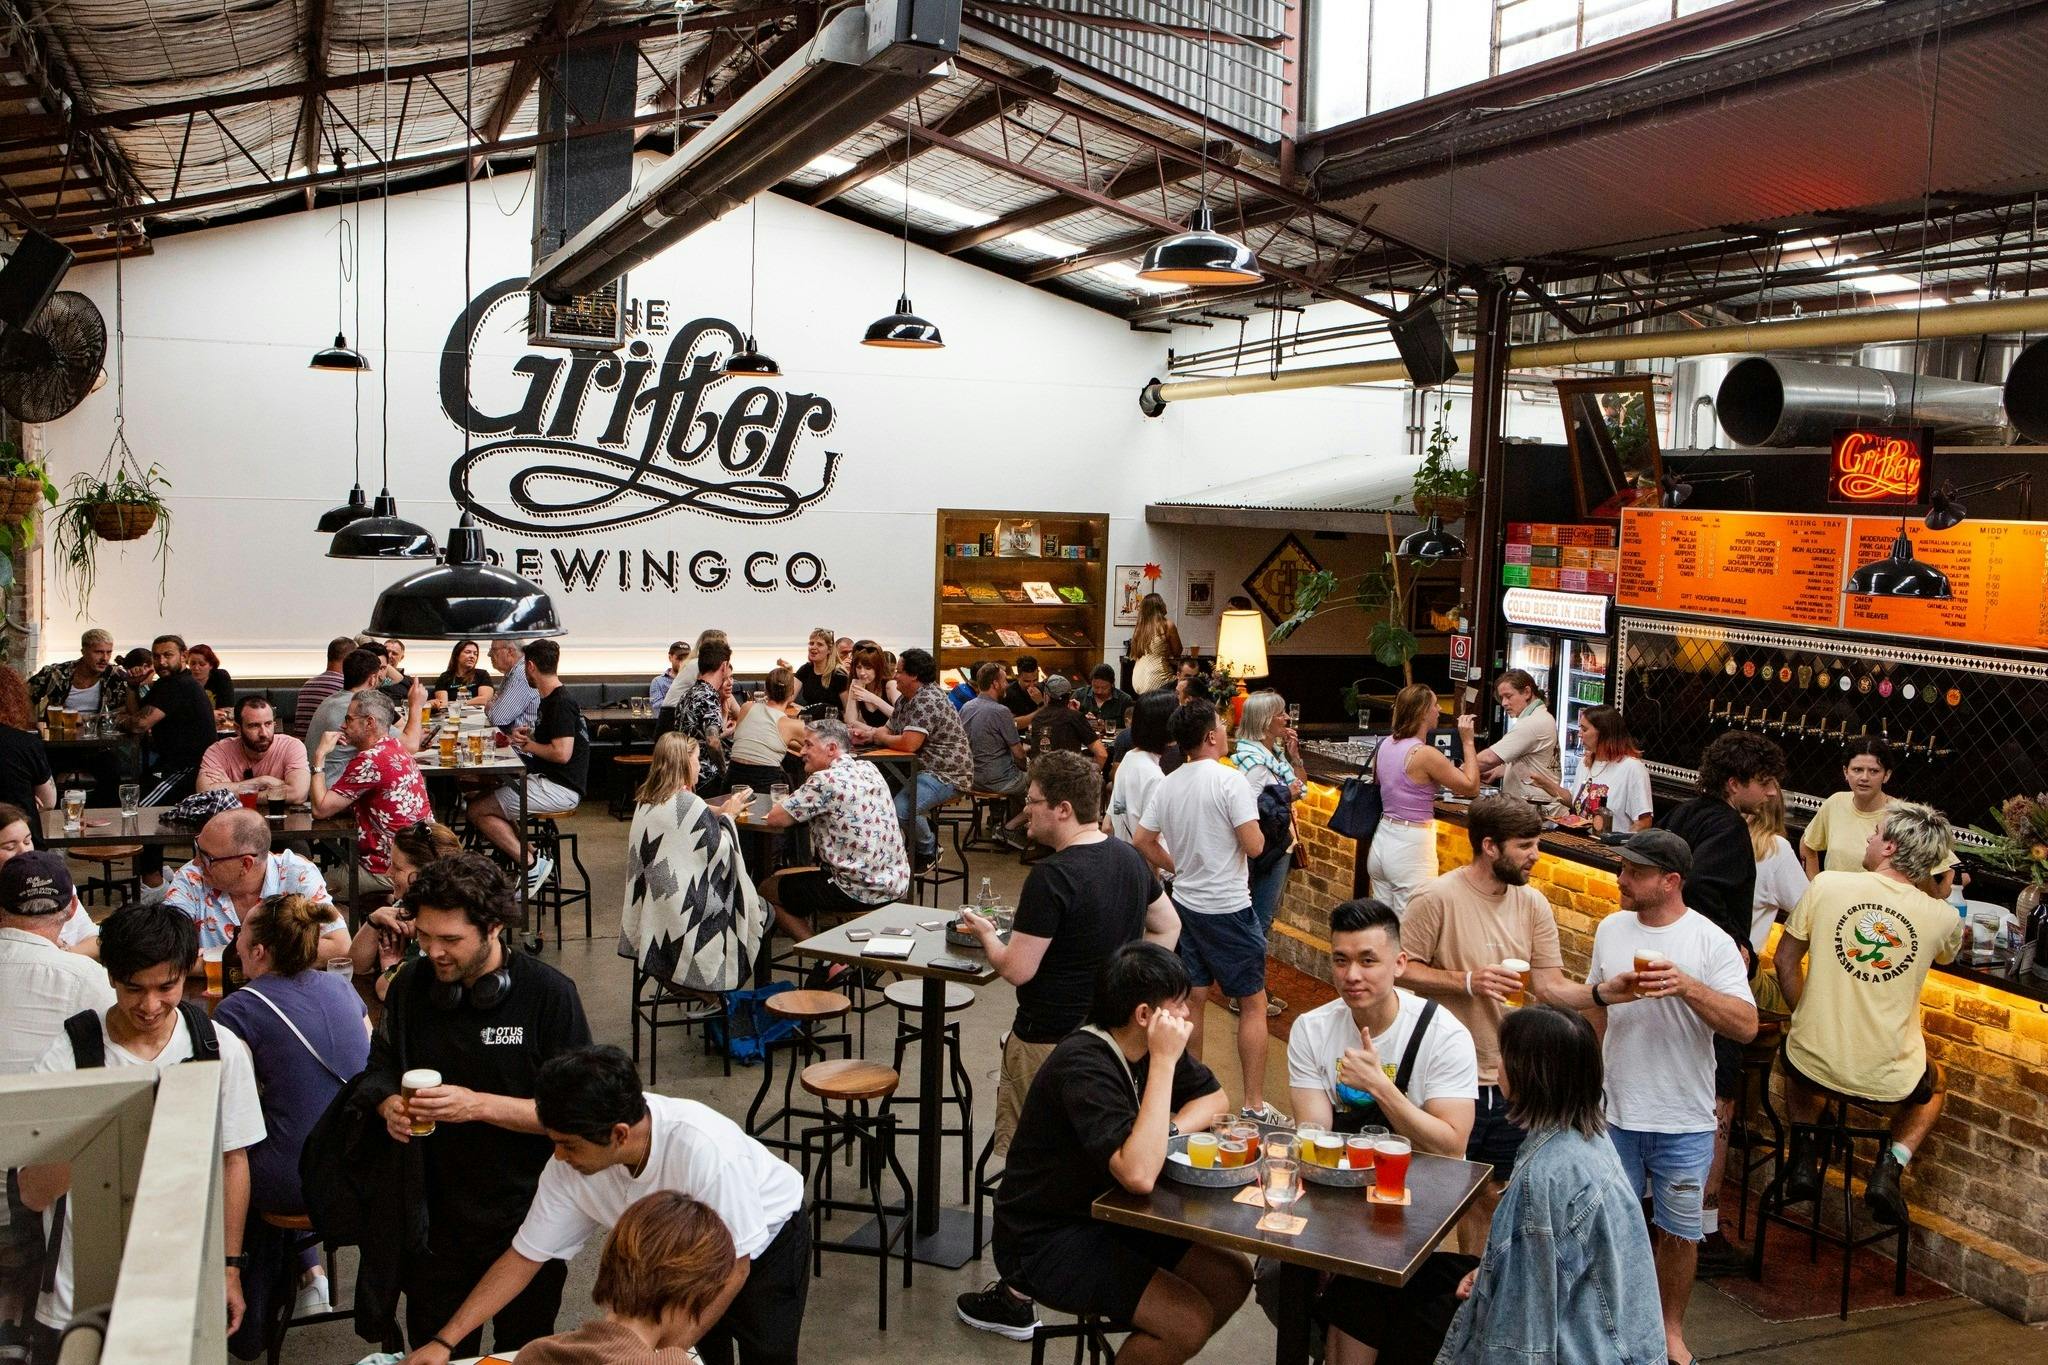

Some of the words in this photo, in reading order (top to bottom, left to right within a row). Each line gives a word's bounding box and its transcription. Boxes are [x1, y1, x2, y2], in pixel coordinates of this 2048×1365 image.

[439, 276, 837, 480] Grifter
[1839, 433, 1921, 482] Grifter
[1875, 437, 1892, 446] THE
[437, 549, 731, 593] EWING
[744, 550, 836, 593] CO.
[1508, 600, 1530, 613] COLD
[1534, 603, 1558, 617] BEER
[1561, 604, 1570, 618] IN
[1574, 606, 1601, 621] HERE
[1837, 915, 1848, 931] THE
[1847, 904, 1883, 915] GRIFTER
[1884, 907, 1917, 939] BREWING
[1835, 937, 1854, 973] FRESH
[1853, 970, 1870, 982] AS
[1872, 974, 1880, 983] A
[1882, 955, 1914, 982] DAISY
[495, 1036, 522, 1044] BORN
